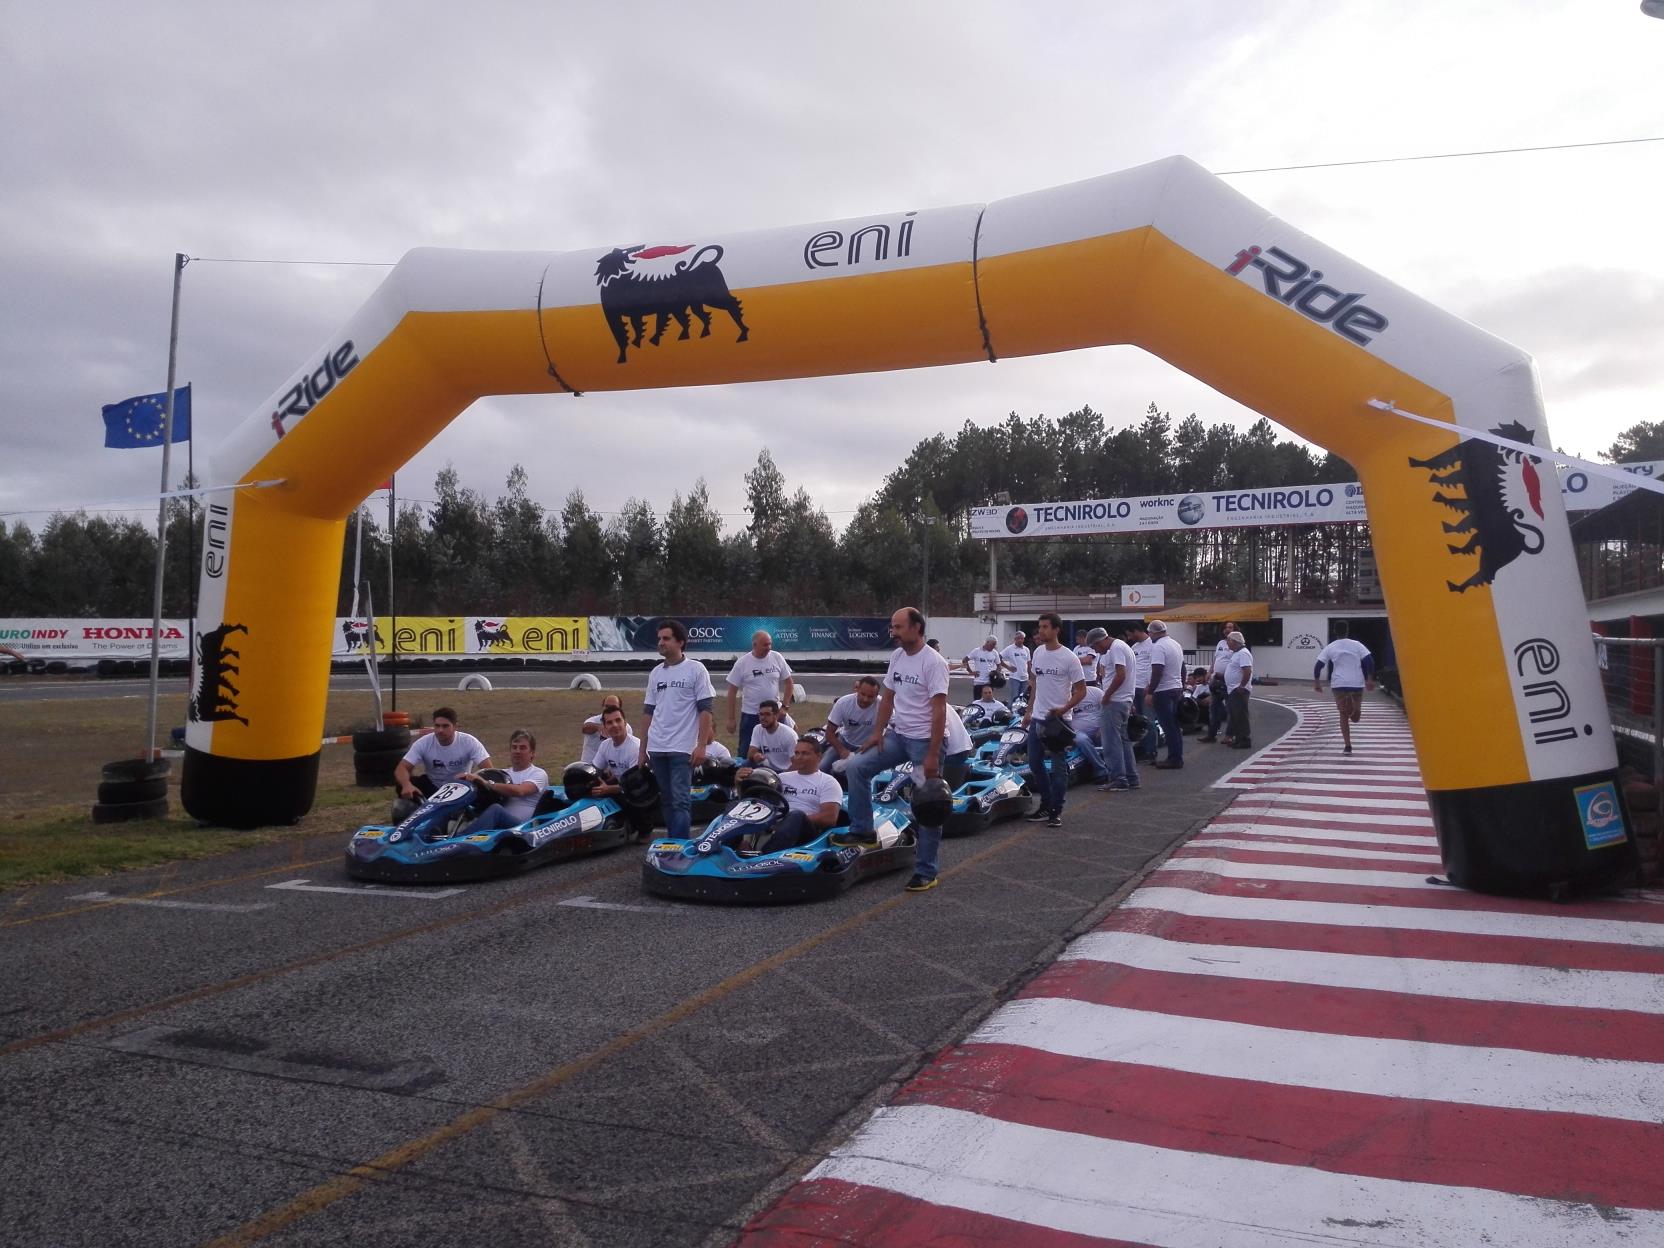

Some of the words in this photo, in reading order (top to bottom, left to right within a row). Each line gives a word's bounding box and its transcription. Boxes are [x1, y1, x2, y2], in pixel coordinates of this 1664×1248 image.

[804, 211, 918, 270] eni
[1224, 245, 1389, 347] iRide
[271, 339, 360, 440] iRide
[1140, 497, 1174, 508] worknc
[1212, 488, 1334, 513] TECNIROLO
[1033, 501, 1131, 522] TECNIROLO
[204, 504, 228, 578] eni
[0, 629, 69, 640] UROINDY
[83, 627, 185, 640] HONDA
[394, 619, 456, 652] eni
[522, 619, 580, 651] eni
[687, 627, 724, 638] OSOC
[671, 678, 685, 688] eni
[905, 674, 919, 685] eni
[1513, 638, 1593, 745] eni
[433, 785, 459, 800] 26
[801, 786, 818, 796] eni
[737, 803, 763, 819] 12
[533, 815, 578, 841] TECNIROLO
